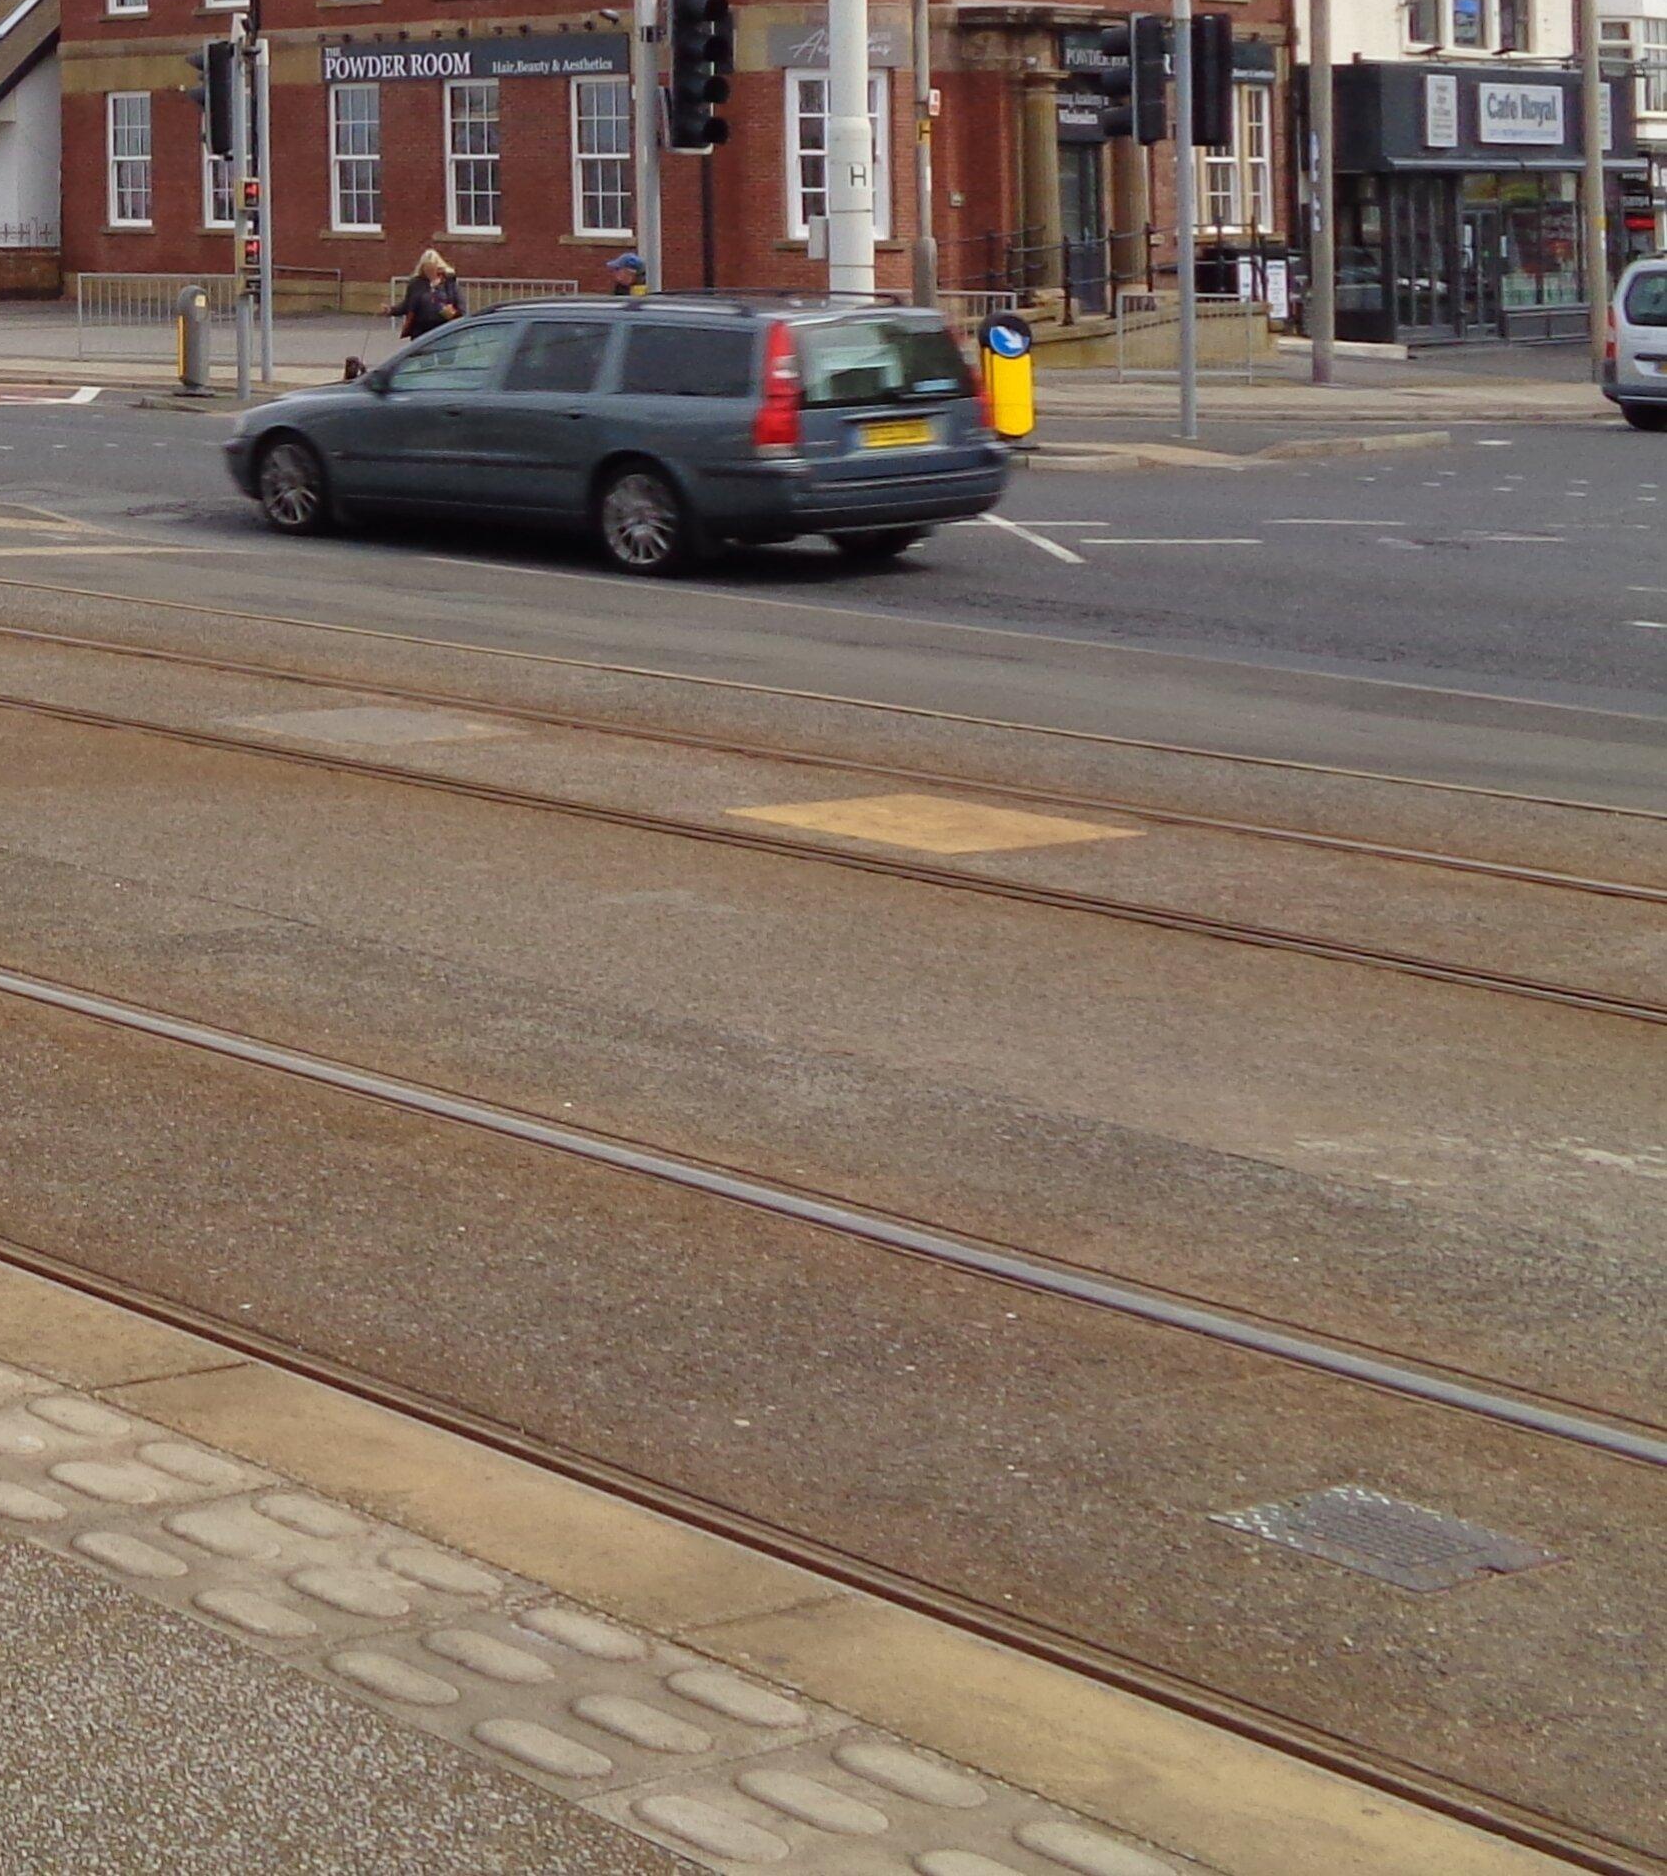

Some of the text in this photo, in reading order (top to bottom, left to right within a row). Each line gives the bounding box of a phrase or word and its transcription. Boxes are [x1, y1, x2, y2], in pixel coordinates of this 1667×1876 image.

[325, 47, 342, 58] THE
[325, 52, 472, 80] POWDER ROOM
[562, 58, 613, 73] Aesthetics
[1520, 93, 1558, 127] Royal
